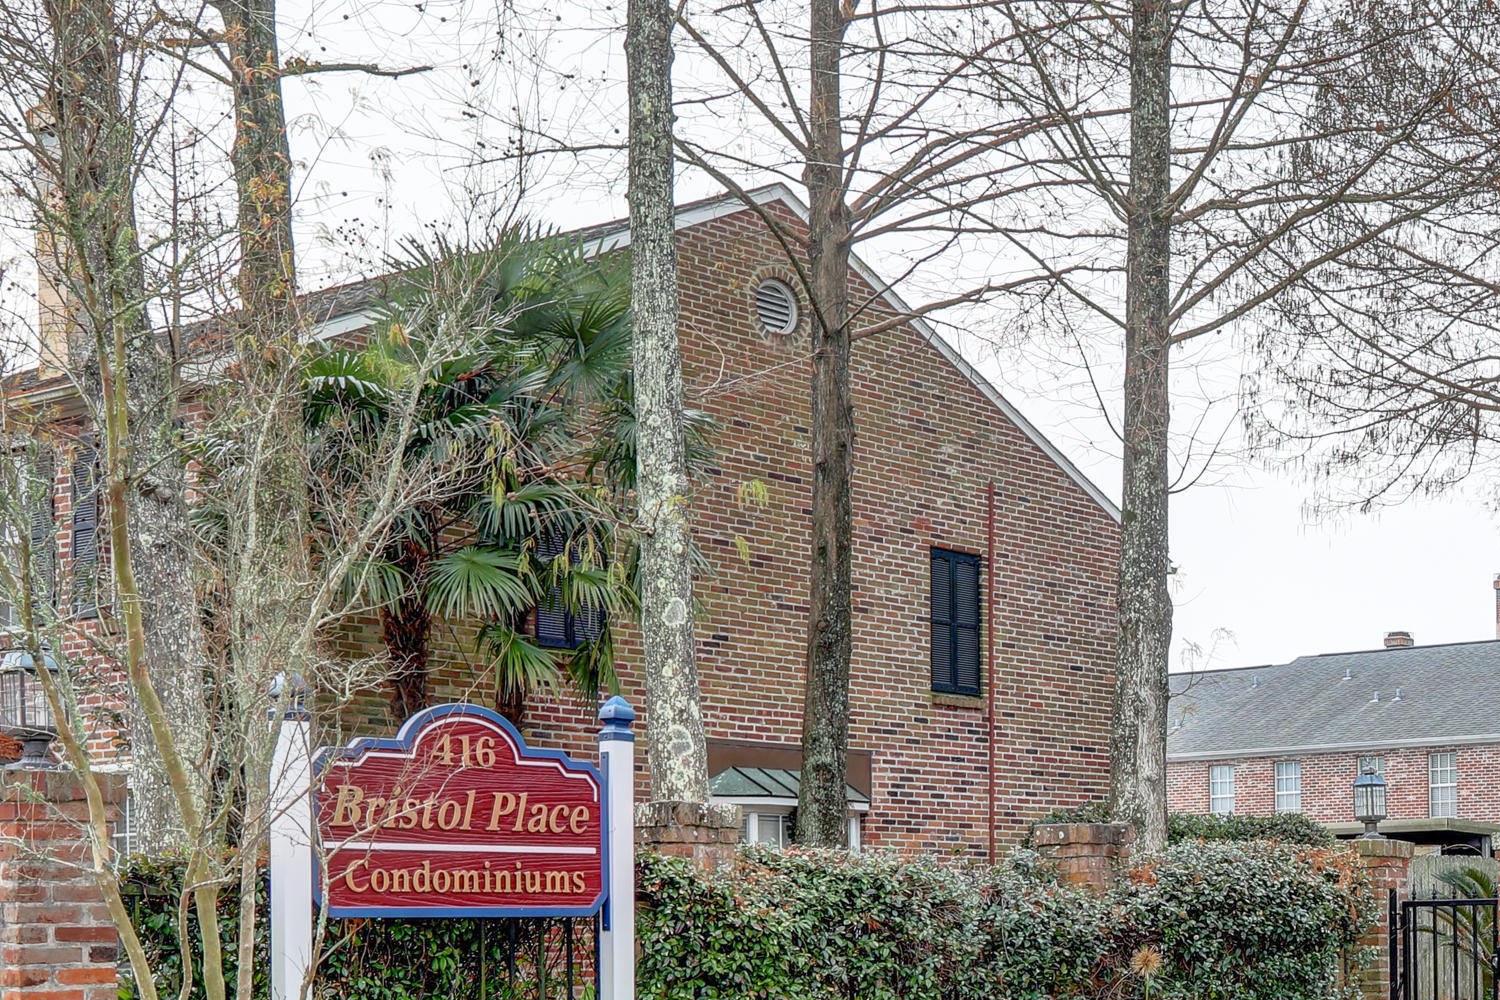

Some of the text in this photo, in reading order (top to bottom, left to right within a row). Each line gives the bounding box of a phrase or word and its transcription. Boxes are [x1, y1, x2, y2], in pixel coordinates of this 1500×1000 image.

[434, 734, 496, 768] 416
[329, 784, 590, 834] Bristol Place
[346, 860, 586, 894] Condominiums
